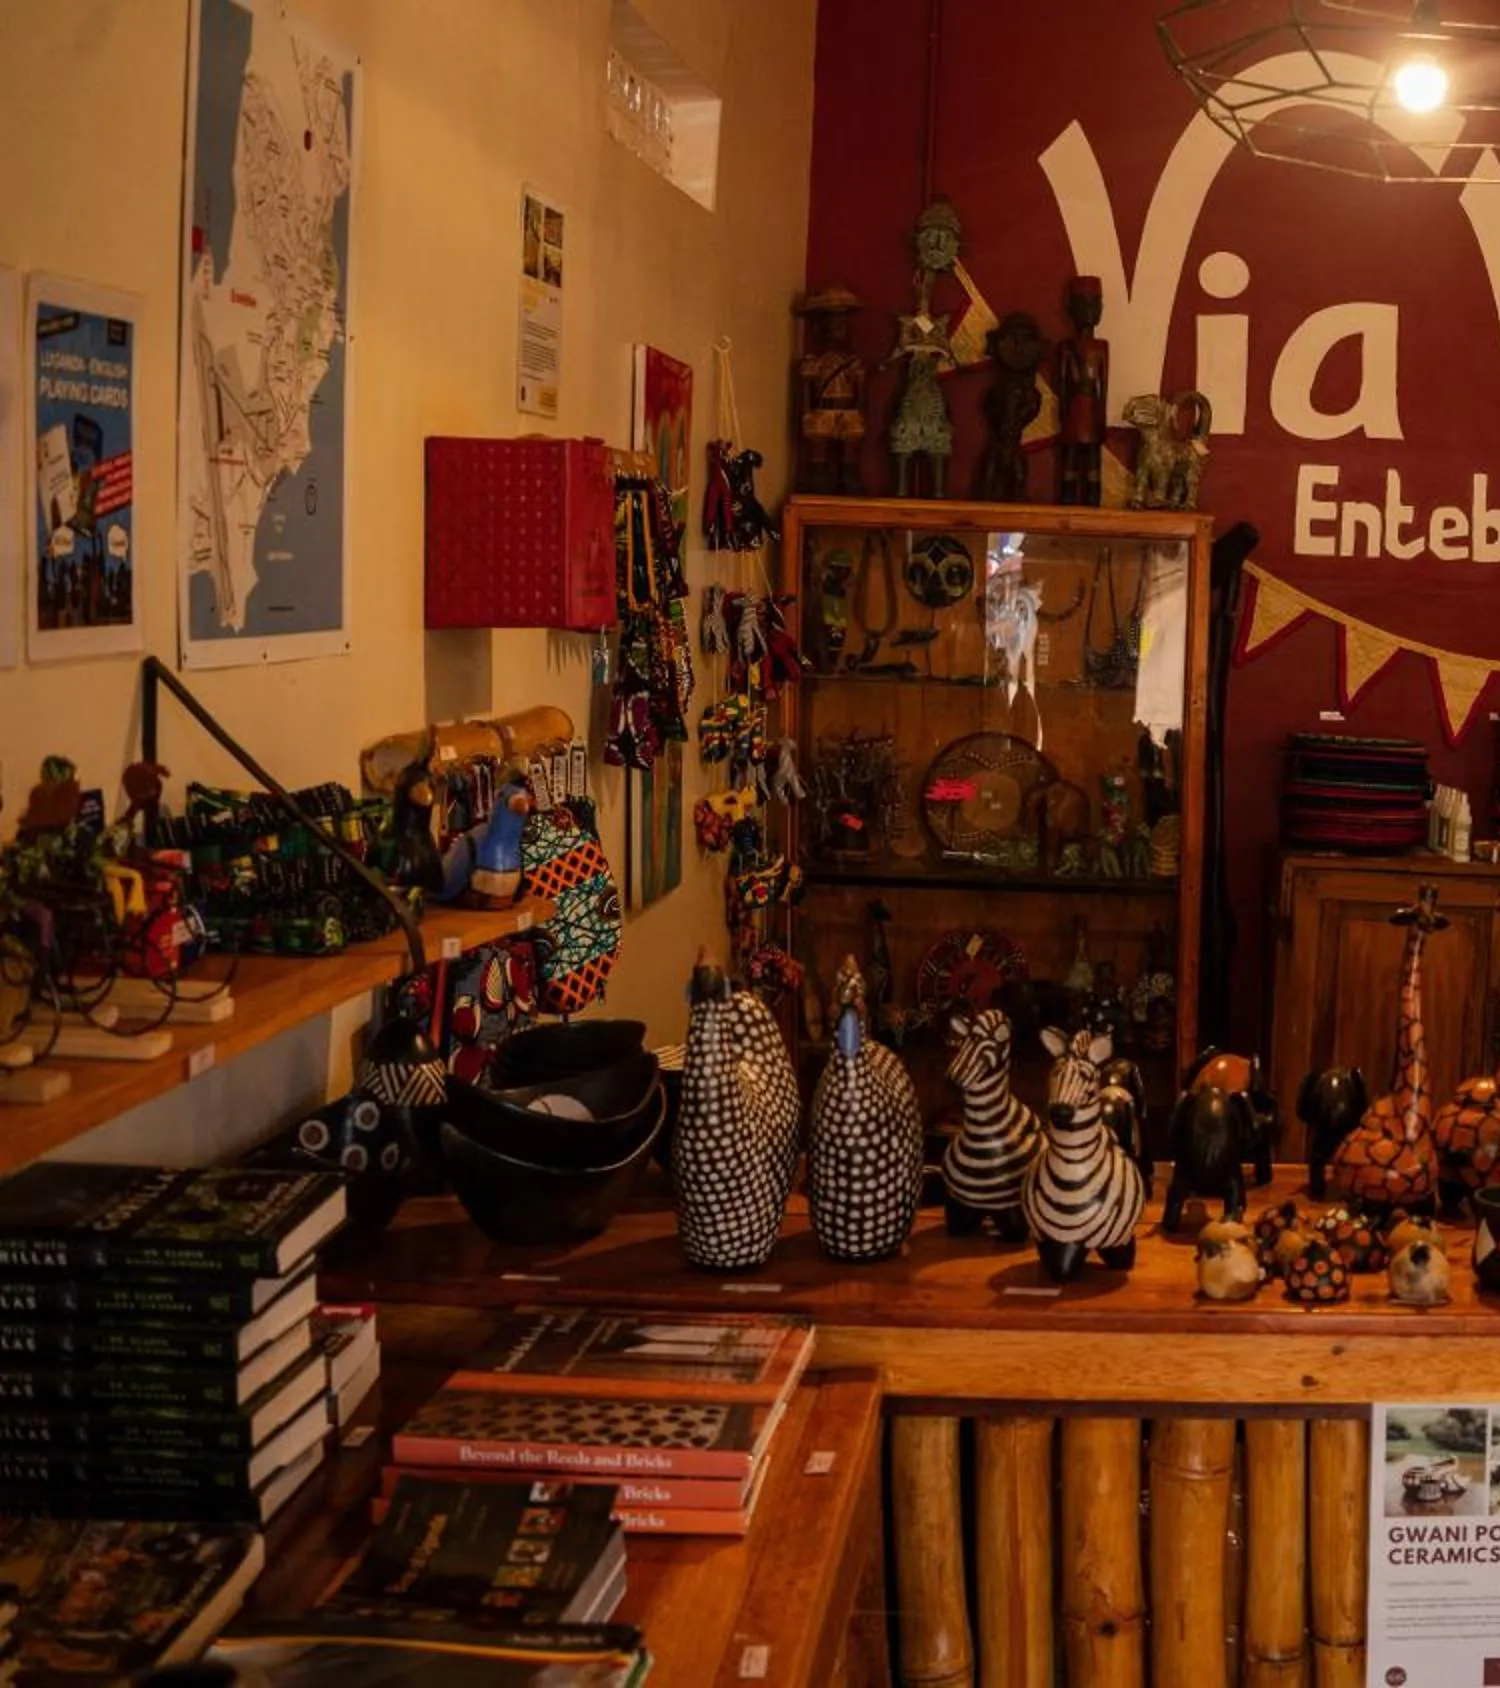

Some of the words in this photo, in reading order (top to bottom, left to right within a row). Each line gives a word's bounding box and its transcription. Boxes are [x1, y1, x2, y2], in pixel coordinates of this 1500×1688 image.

[1038, 50, 1466, 441] Via
[0, 1249, 68, 1266] RILLAS
[459, 1445, 516, 1464] Beyond
[519, 1448, 543, 1464] the
[546, 1450, 590, 1466] Reeds
[592, 1451, 623, 1467] and
[625, 1453, 673, 1469] Bricks
[623, 1485, 671, 1501] Bricks
[1388, 1525, 1468, 1544] GWANI
